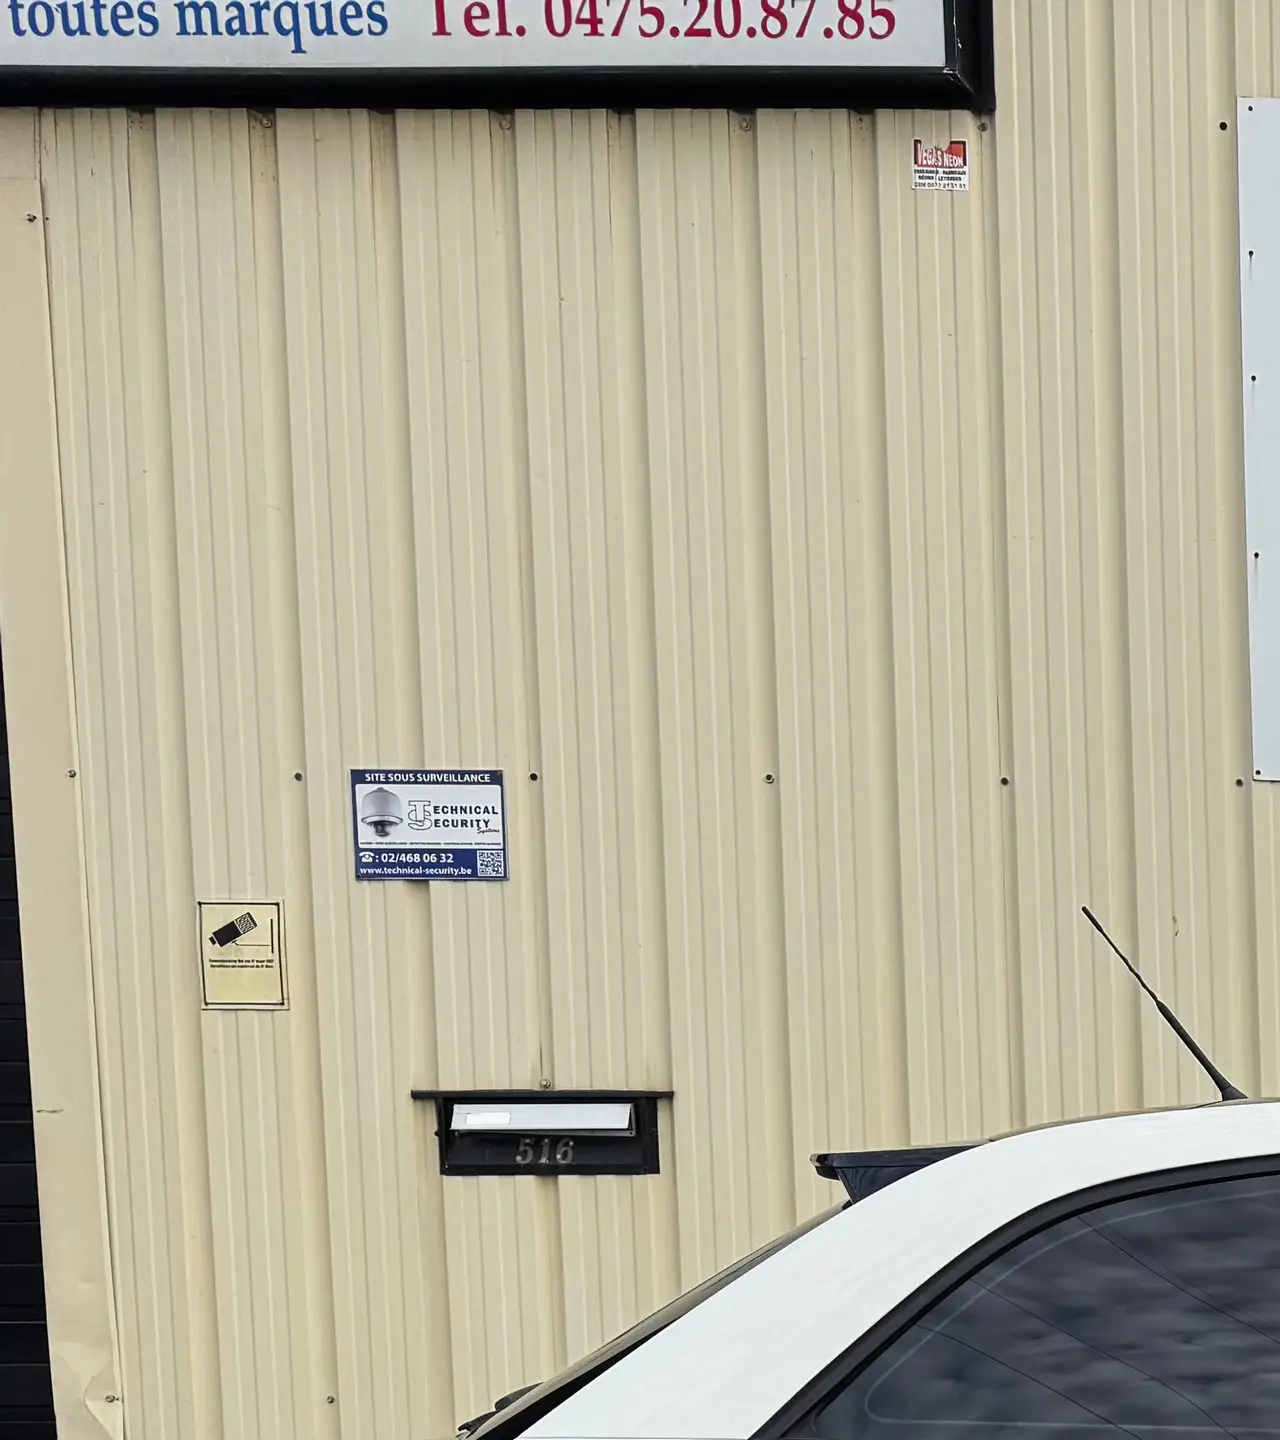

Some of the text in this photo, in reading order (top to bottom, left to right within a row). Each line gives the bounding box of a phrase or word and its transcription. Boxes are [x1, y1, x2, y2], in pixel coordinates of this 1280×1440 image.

[8, 0, 160, 37] toutes
[174, 0, 389, 54] marques
[544, 0, 896, 40] 0475.20.87.85
[365, 773, 491, 784] SITE SOUS SURVEILLANCE
[381, 853, 421, 863] 02/468
[423, 853, 438, 863] 06
[440, 853, 454, 863] 32
[359, 866, 472, 876] www.technical-security.be
[515, 1136, 575, 1165] 516
